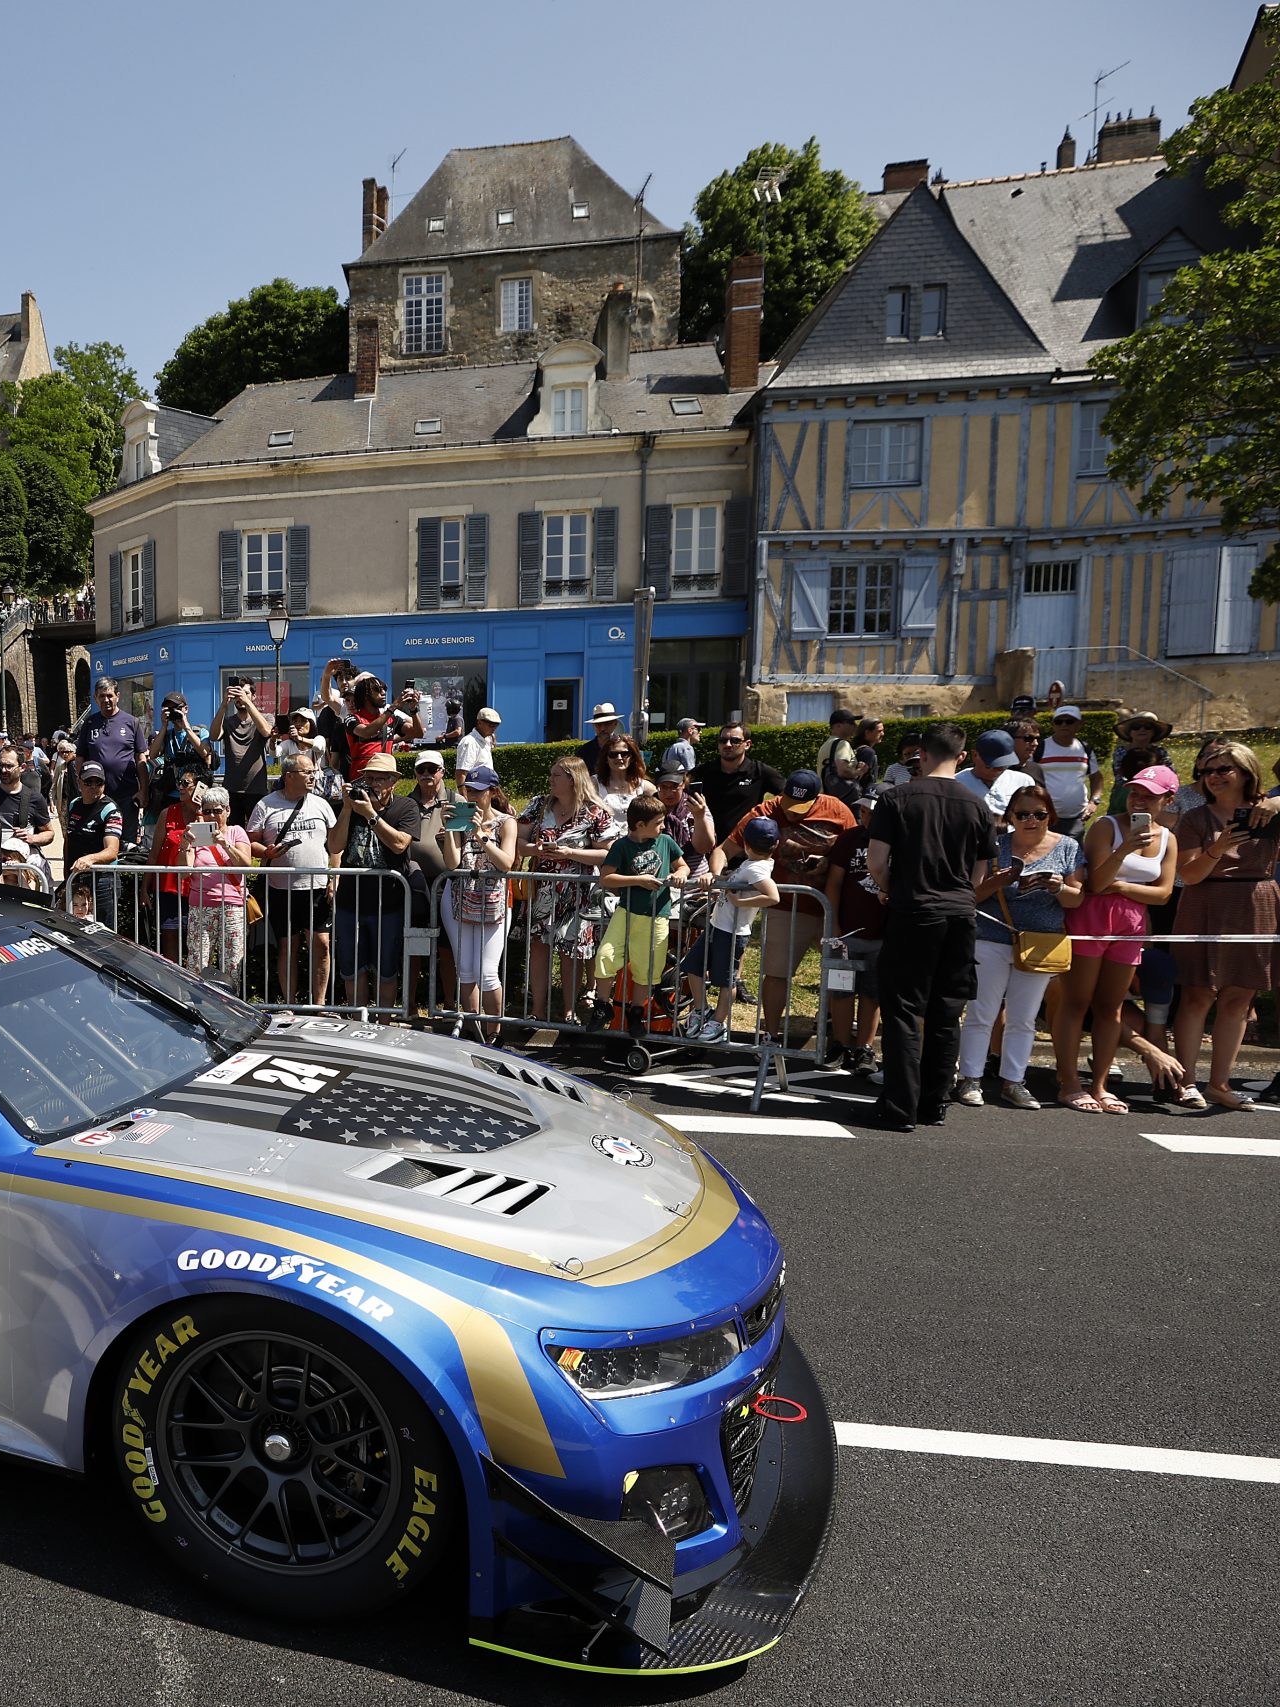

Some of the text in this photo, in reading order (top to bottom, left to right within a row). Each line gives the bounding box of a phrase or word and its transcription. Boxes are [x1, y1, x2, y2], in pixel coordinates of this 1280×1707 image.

[245, 644, 282, 652] HANDICA
[405, 636, 475, 646] AIDE AUX SENIORS
[10, 931, 75, 957] NASR
[253, 1057, 341, 1094] 24
[177, 1248, 395, 1323] GOODYEAR
[385, 1465, 438, 1581] EAGLE
